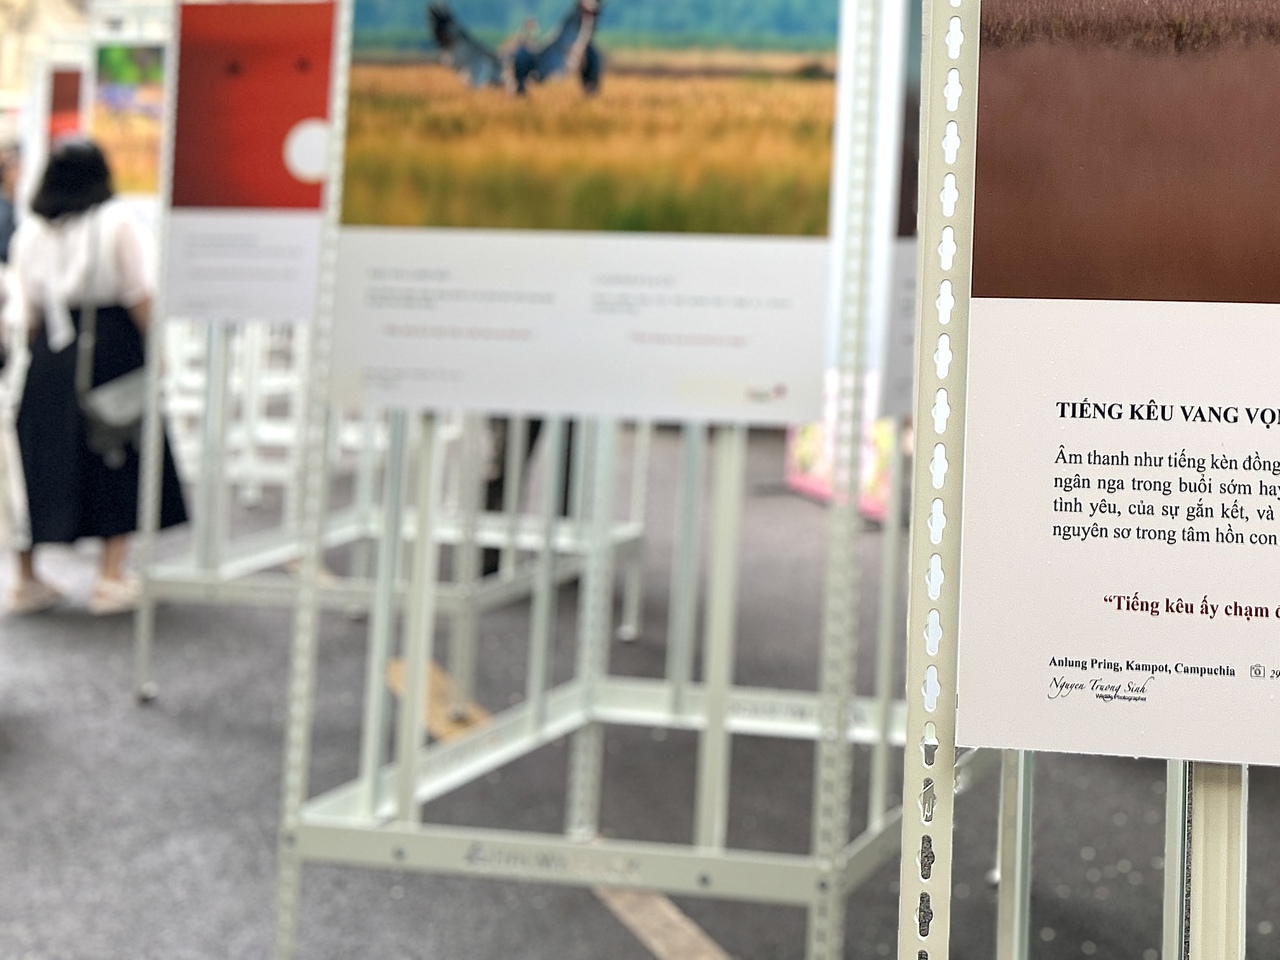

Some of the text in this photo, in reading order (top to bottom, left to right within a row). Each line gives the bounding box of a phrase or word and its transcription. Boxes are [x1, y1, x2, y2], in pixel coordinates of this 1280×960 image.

[1056, 397, 1123, 420] TIẾNG
[1129, 399, 1174, 421] KÊU
[1180, 405, 1239, 423] VANG
[1054, 444, 1083, 464] Âm
[1087, 450, 1129, 466] thanh
[1134, 451, 1164, 467] như
[1167, 448, 1206, 473] tiếng
[1210, 454, 1238, 470] kèn
[1054, 473, 1091, 492] ngân
[1097, 479, 1125, 494] nga
[1131, 477, 1172, 496] trong
[1179, 473, 1212, 494] buổi
[1219, 479, 1252, 495] sớm
[1053, 497, 1083, 513] tình
[1089, 498, 1121, 518] yêu,
[1128, 500, 1155, 516] của
[1161, 505, 1180, 520] sự
[1186, 498, 1214, 522] gắn
[1221, 499, 1249, 522] kết,
[1256, 505, 1275, 521] và
[1053, 522, 1108, 541] nguyên
[1113, 527, 1132, 539] sơ
[1136, 526, 1177, 545] trong
[1182, 526, 1210, 542] tâm
[1215, 523, 1244, 544] hồn
[1249, 533, 1277, 545] con
[1104, 592, 1160, 616] “Tiếng
[1165, 598, 1194, 614] kêu
[1200, 595, 1219, 619] ấy
[1224, 601, 1269, 621] chạm
[1049, 656, 1235, 677] Anlung Pring, Kampot, Campuchia
